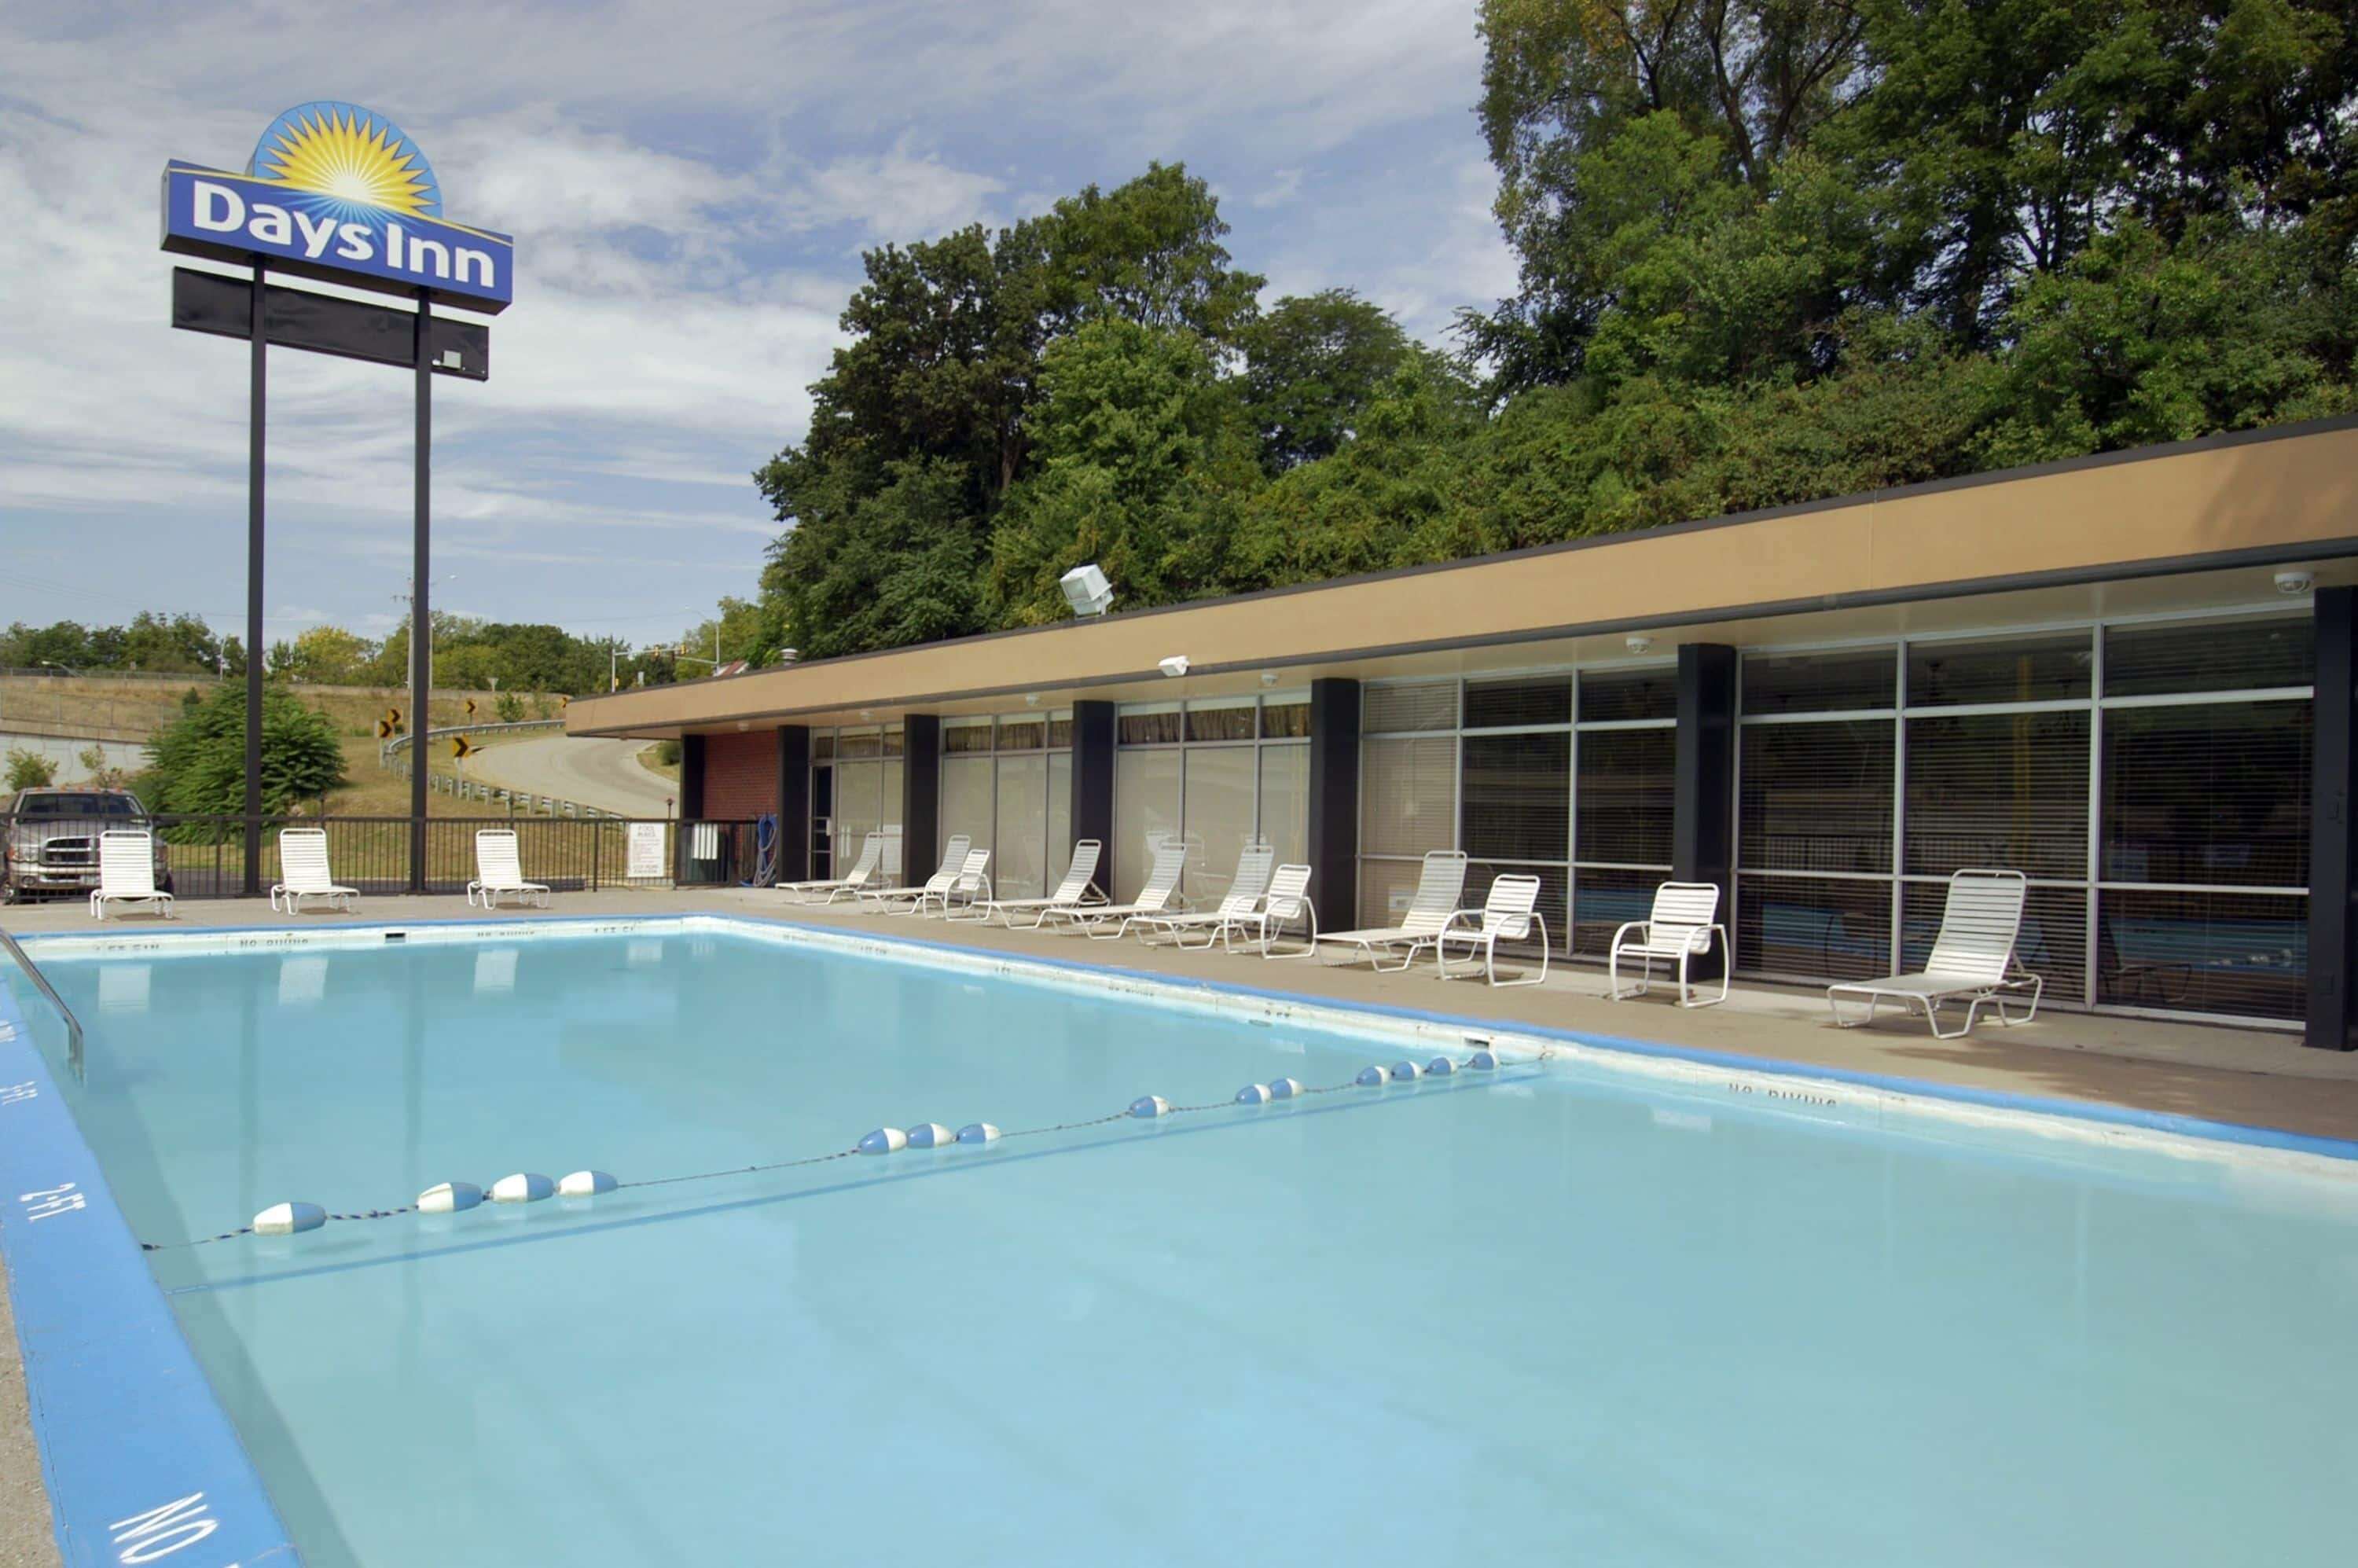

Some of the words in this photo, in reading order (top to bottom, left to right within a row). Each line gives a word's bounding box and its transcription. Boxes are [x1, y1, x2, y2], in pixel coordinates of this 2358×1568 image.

[193, 180, 374, 262] Days
[387, 223, 495, 288] Inn
[108, 1491, 219, 1564] NO
